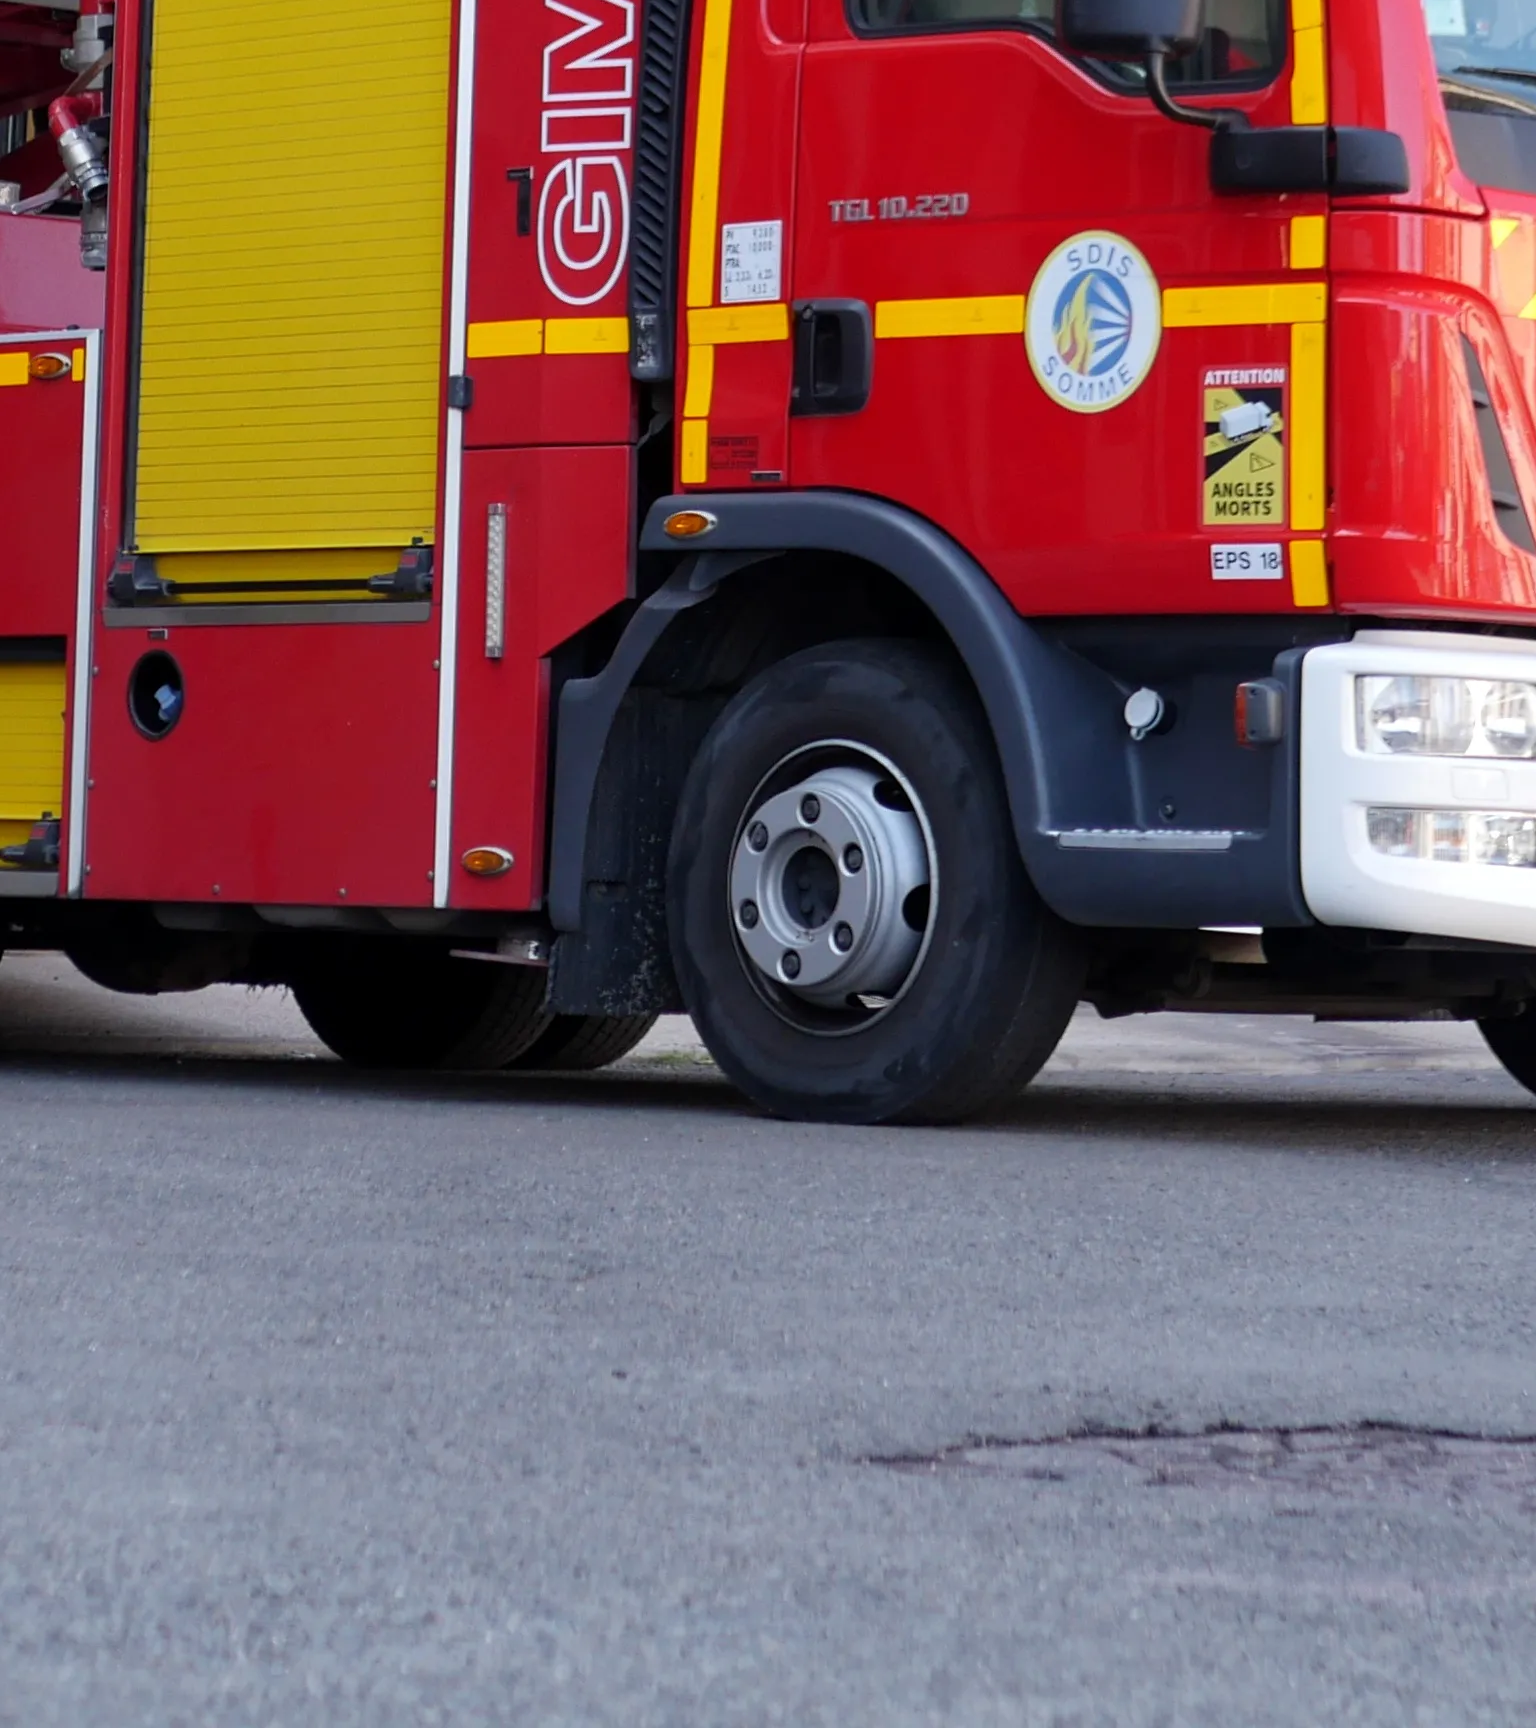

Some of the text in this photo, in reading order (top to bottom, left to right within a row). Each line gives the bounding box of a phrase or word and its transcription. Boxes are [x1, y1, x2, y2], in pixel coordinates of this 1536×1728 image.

[828, 192, 969, 222] TGL 10.220
[1067, 244, 1133, 278] SDIS
[1042, 355, 1135, 401] SOMME
[1204, 368, 1286, 385] ATTENTION
[1212, 482, 1275, 498] ANGLES
[1215, 501, 1272, 516] MORTS
[1213, 552, 1278, 570] EPS 18
